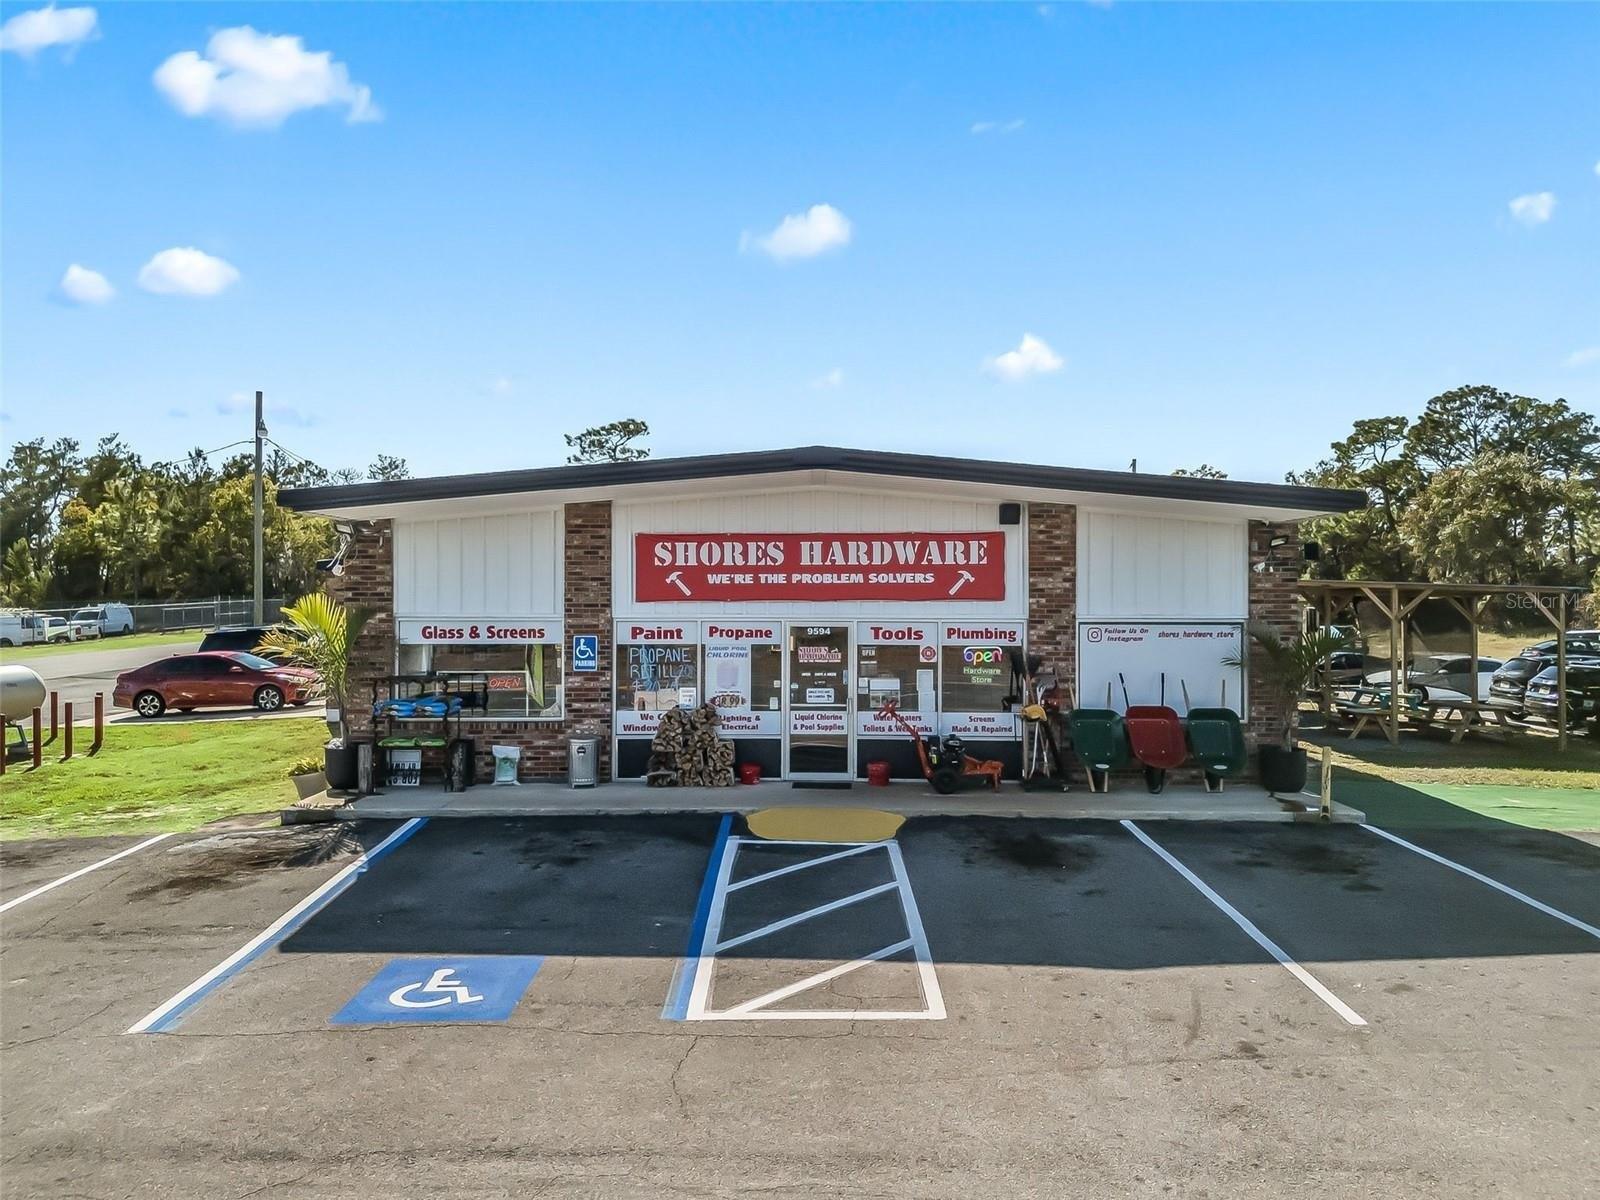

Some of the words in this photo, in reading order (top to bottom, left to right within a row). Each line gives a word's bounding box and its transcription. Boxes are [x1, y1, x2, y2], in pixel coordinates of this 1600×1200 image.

[654, 541, 785, 566] SHORES
[800, 540, 988, 566] HARDWARE
[707, 573, 754, 584] WE'RE
[759, 573, 787, 584] THE
[792, 573, 864, 584] PROBLEM
[868, 573, 936, 584] SOLVERS
[421, 626, 464, 640] Glass
[468, 626, 480, 639] &
[486, 626, 545, 640] Screens
[631, 626, 684, 640] Paint
[708, 626, 773, 640] Propane
[807, 627, 831, 636] 9594
[870, 626, 924, 640] Tools
[946, 628, 1017, 642] Plumbing
[629, 648, 692, 664] PROPANE
[964, 650, 1003, 665] open
[489, 678, 521, 688] OPEN
